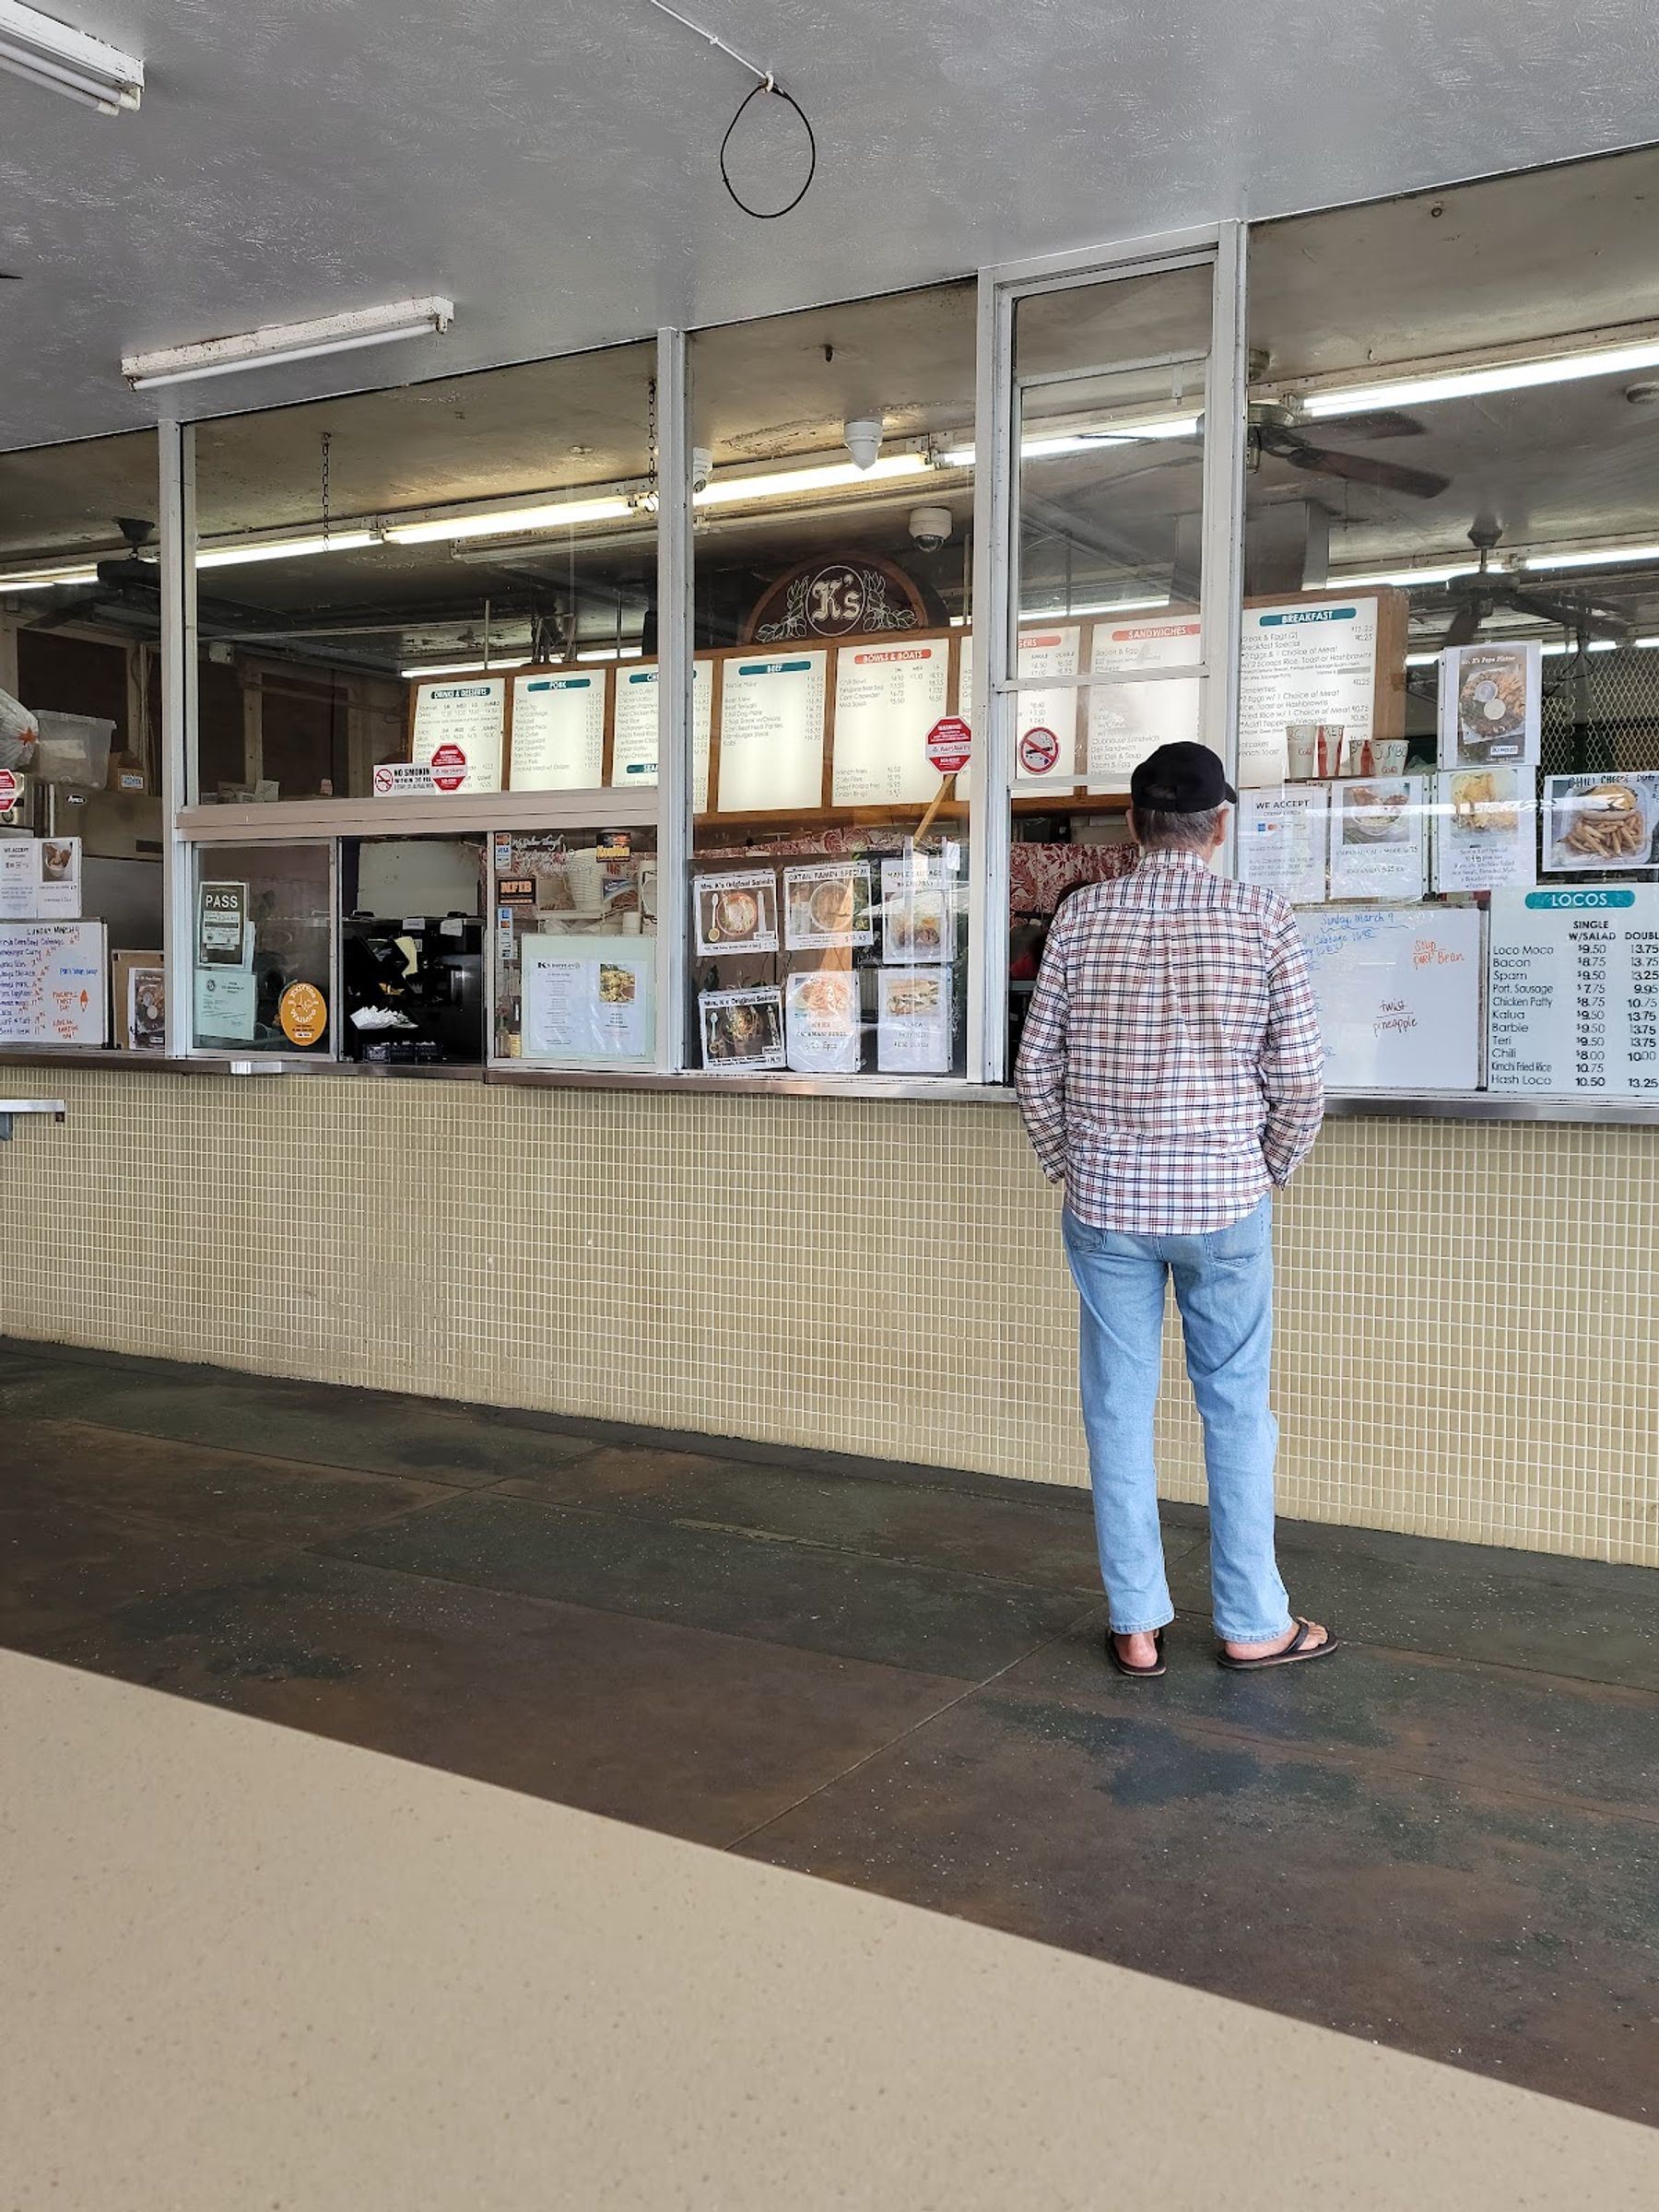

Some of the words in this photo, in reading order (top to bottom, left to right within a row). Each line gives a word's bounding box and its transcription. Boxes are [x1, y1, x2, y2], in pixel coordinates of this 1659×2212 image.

[1281, 610, 1334, 624] BREAKFAST
[1128, 626, 1186, 640] SANDWICHES
[1018, 638, 1037, 648] GERS
[1281, 648, 1308, 657] Choice
[1283, 691, 1309, 700] Choice
[1286, 700, 1328, 708] Hashbrowns
[1293, 708, 1320, 717] Choice
[1330, 706, 1350, 714] Meat
[1124, 752, 1142, 761] Soup
[404, 768, 430, 776] SMOKIN
[1273, 799, 1310, 808] ACCEPT
[206, 894, 238, 909] PASS
[1551, 892, 1608, 907] LOCOS
[1355, 912, 1384, 923] March
[1388, 912, 1394, 923] 9
[1572, 920, 1609, 929] SINGLE
[1568, 931, 1617, 941] W/SALAD
[1624, 931, 1659, 940] DOUBL
[1493, 946, 1520, 955] Loco
[1522, 946, 1554, 955] Moco
[1577, 944, 1606, 954] $9.50
[1630, 944, 1659, 954] 13.75
[1492, 958, 1531, 968] Bacon
[1577, 957, 1606, 967] $8.75
[1630, 957, 1659, 967] 13.75
[1493, 970, 1528, 982] Spam
[1577, 970, 1606, 981] $9.50
[1630, 970, 1659, 981] 13.25
[1492, 983, 1512, 994] Port.
[1513, 983, 1554, 995] Sausage
[1633, 983, 1659, 994] 9.95
[1492, 996, 1529, 1006] Chicken
[1530, 996, 1554, 1008] Patty
[1577, 996, 1606, 1007] $8.75
[1627, 997, 1657, 1008] 10.75
[1492, 1009, 1525, 1020] Kalua
[1577, 1010, 1605, 1020] $9.50
[1627, 1010, 1657, 1021] 13.75
[1491, 1022, 1529, 1033] Barbie
[1576, 1023, 1606, 1033] $9.50
[1630, 1024, 1657, 1035] 13.75
[1492, 1035, 1512, 1045] Teri
[1576, 1036, 1606, 1047] $9.50
[1630, 1037, 1657, 1048] 13.75
[1491, 1048, 1517, 1058] Chili
[1575, 1049, 1606, 1061] $8.00
[1516, 1061, 1535, 1072] Fried
[1535, 1061, 1553, 1073] Rice
[1575, 1063, 1605, 1073] 10.75
[1491, 1074, 1520, 1085] Hash
[1522, 1075, 1553, 1086] Loco
[1574, 1077, 1606, 1087] 10.50
[1628, 1077, 1659, 1088] 13.25
